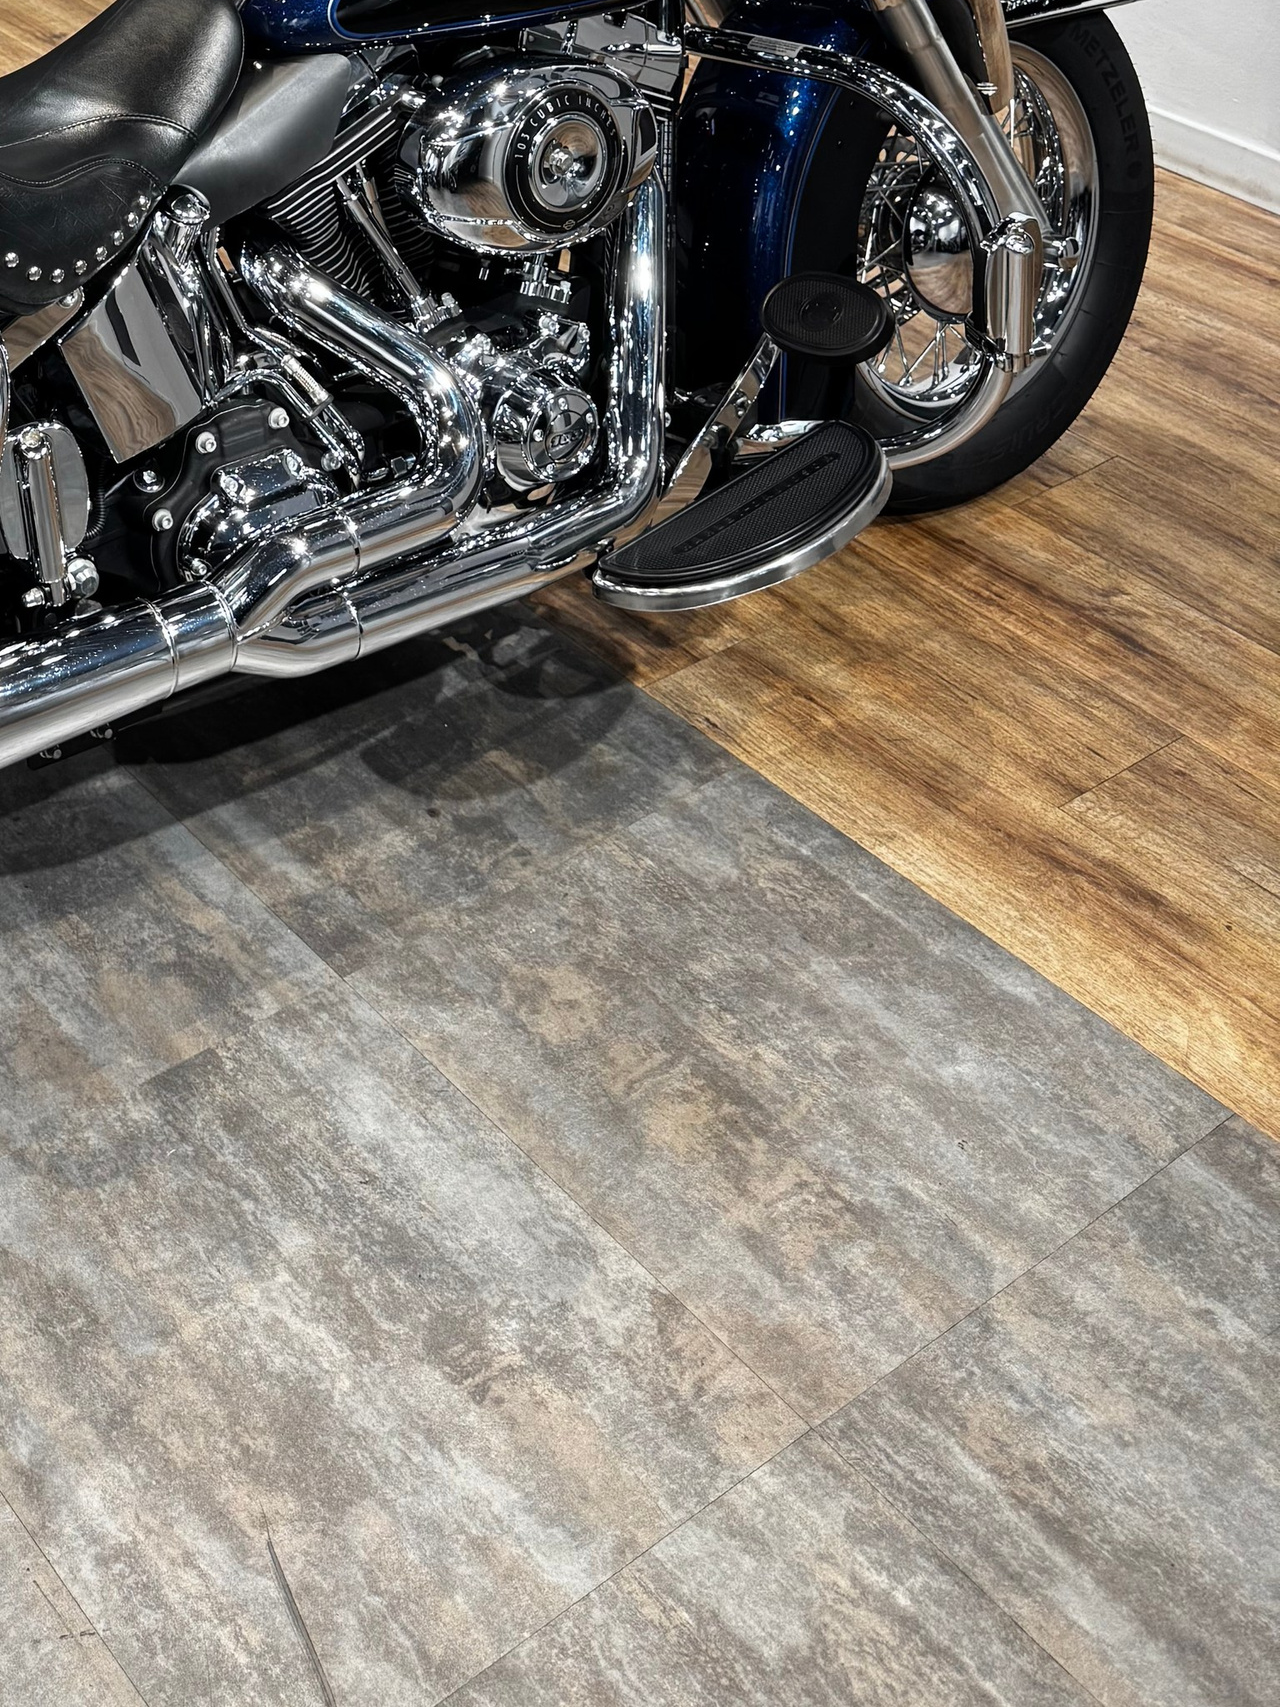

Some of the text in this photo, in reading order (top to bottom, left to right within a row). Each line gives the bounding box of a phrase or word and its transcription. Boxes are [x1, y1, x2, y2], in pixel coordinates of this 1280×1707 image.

[514, 94, 617, 158] 103 CUBIC INCHES
[1070, 25, 1141, 155] METZELER
